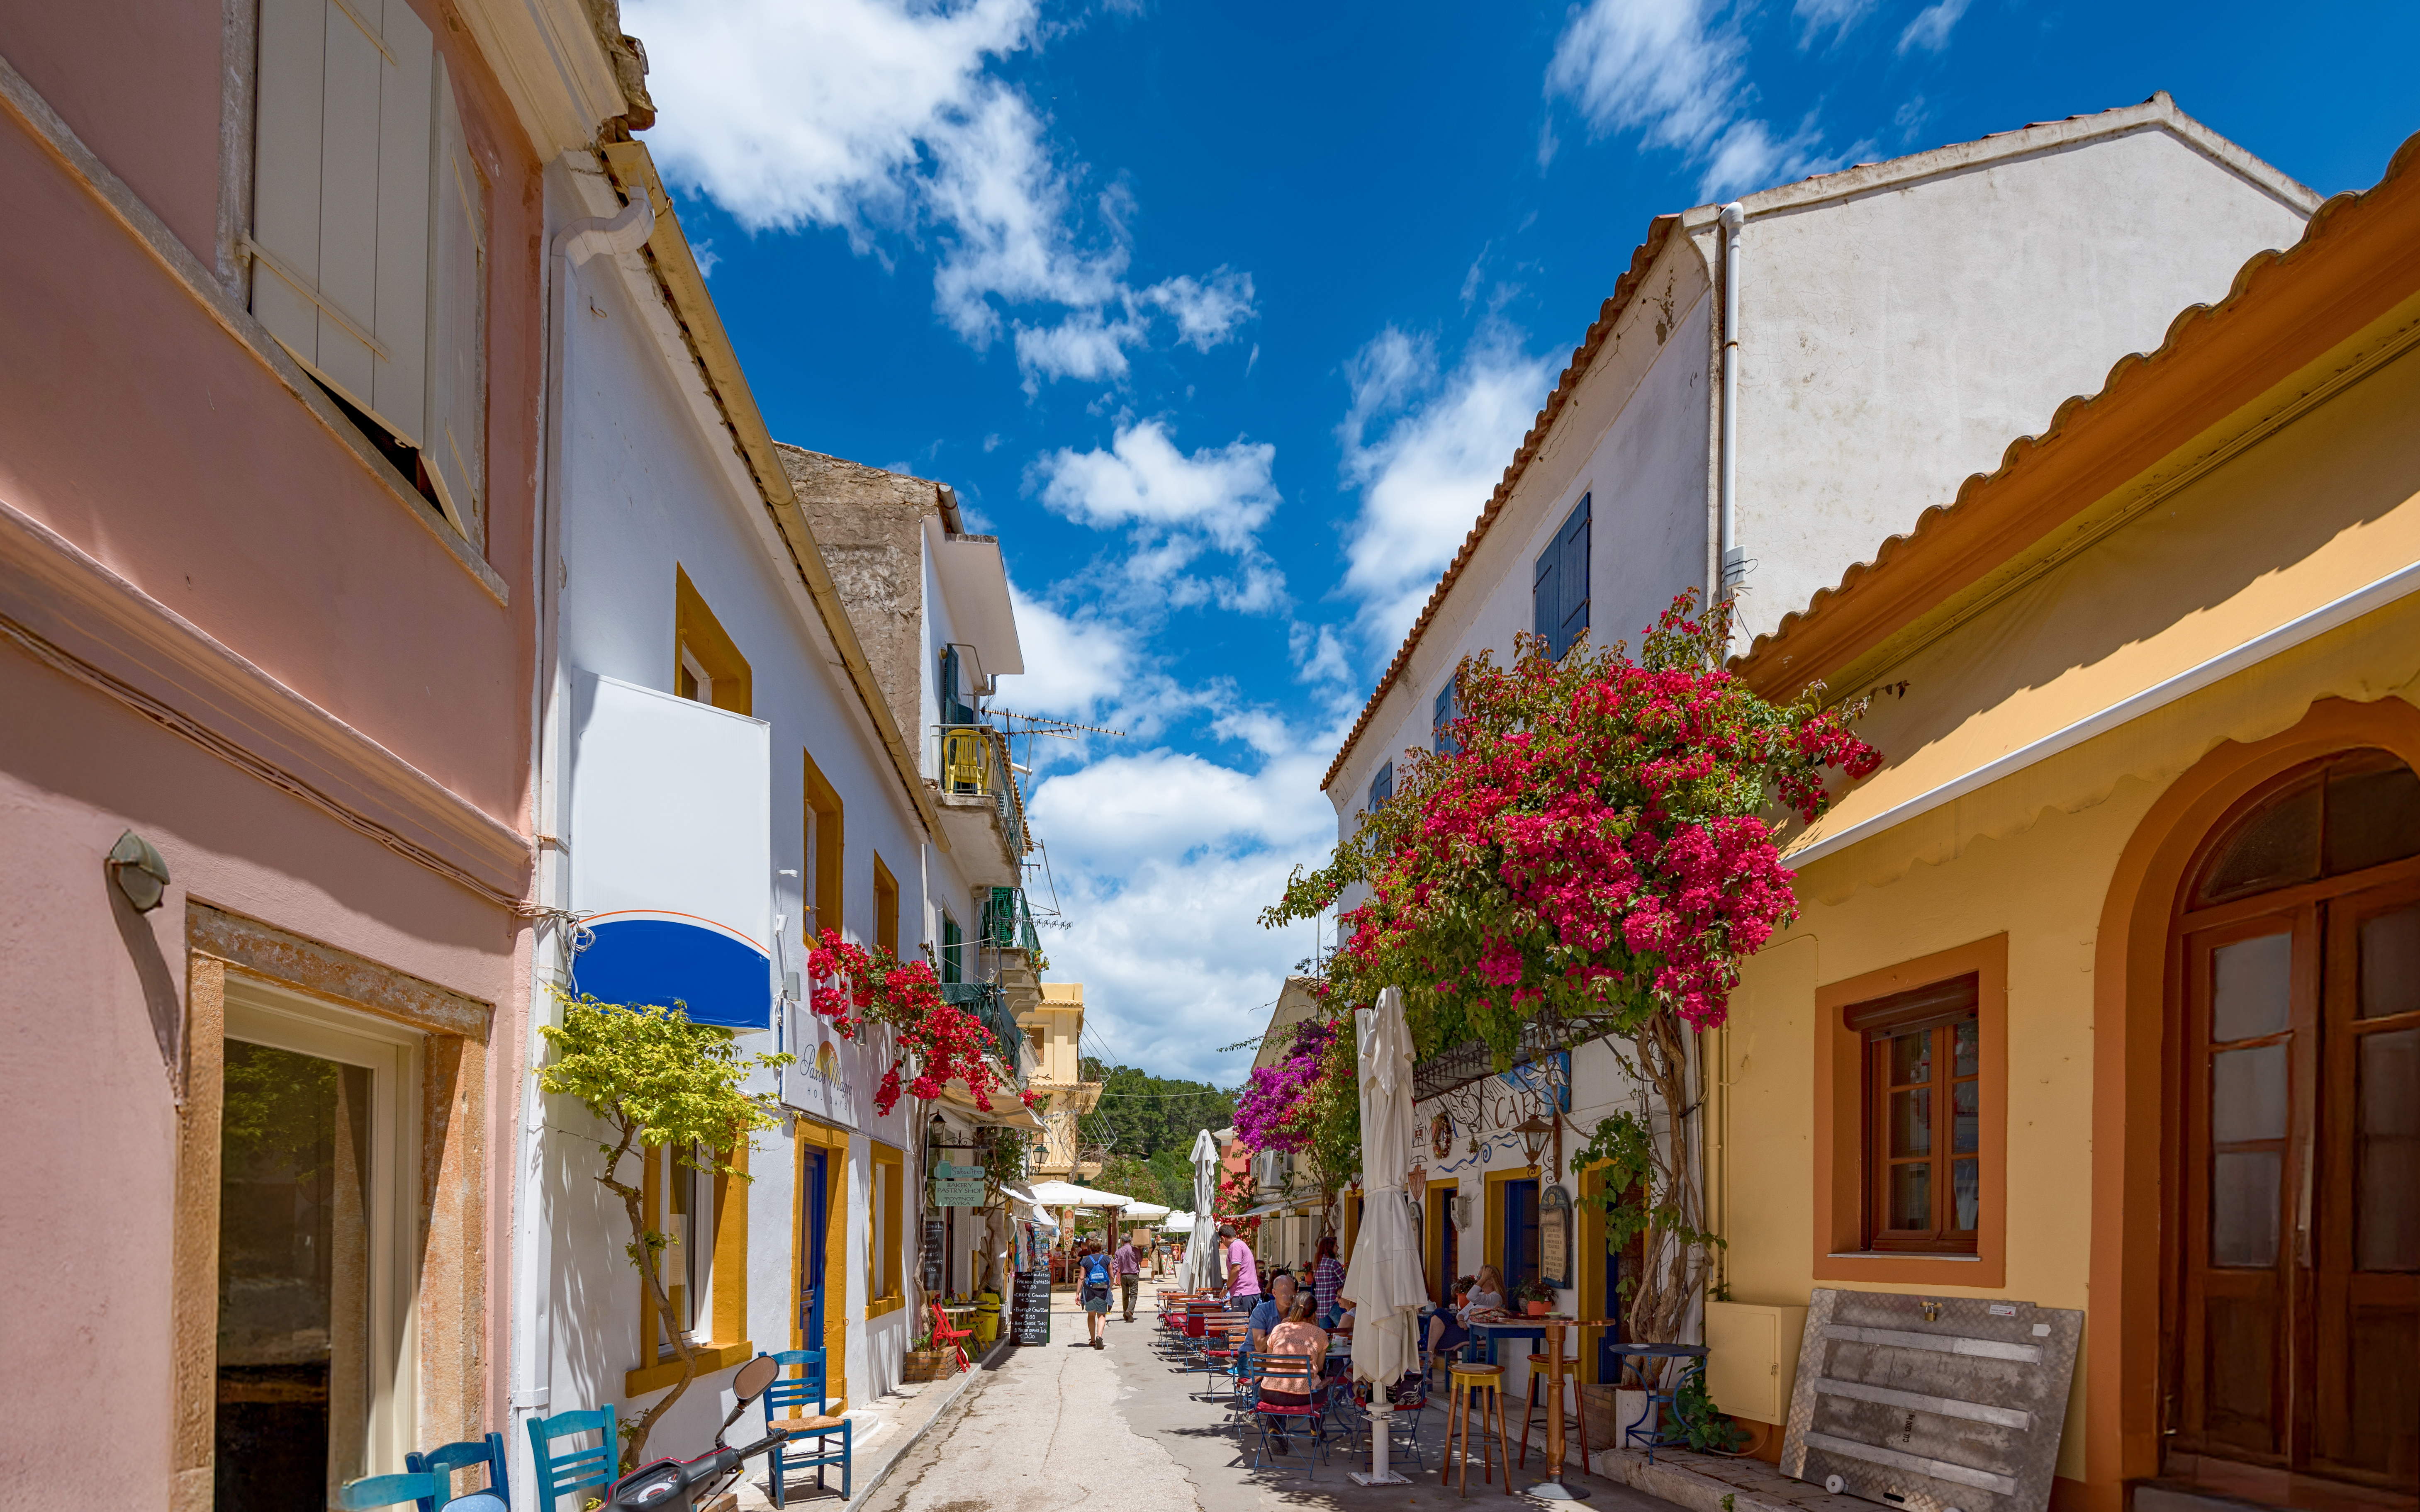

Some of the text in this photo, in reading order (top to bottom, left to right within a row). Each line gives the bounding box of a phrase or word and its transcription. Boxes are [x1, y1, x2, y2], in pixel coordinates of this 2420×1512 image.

[800, 1044, 852, 1098] Paxos Magic
[808, 1087, 847, 1110] HOLIDAYS
[952, 1167, 982, 1175] Sakoulitsa
